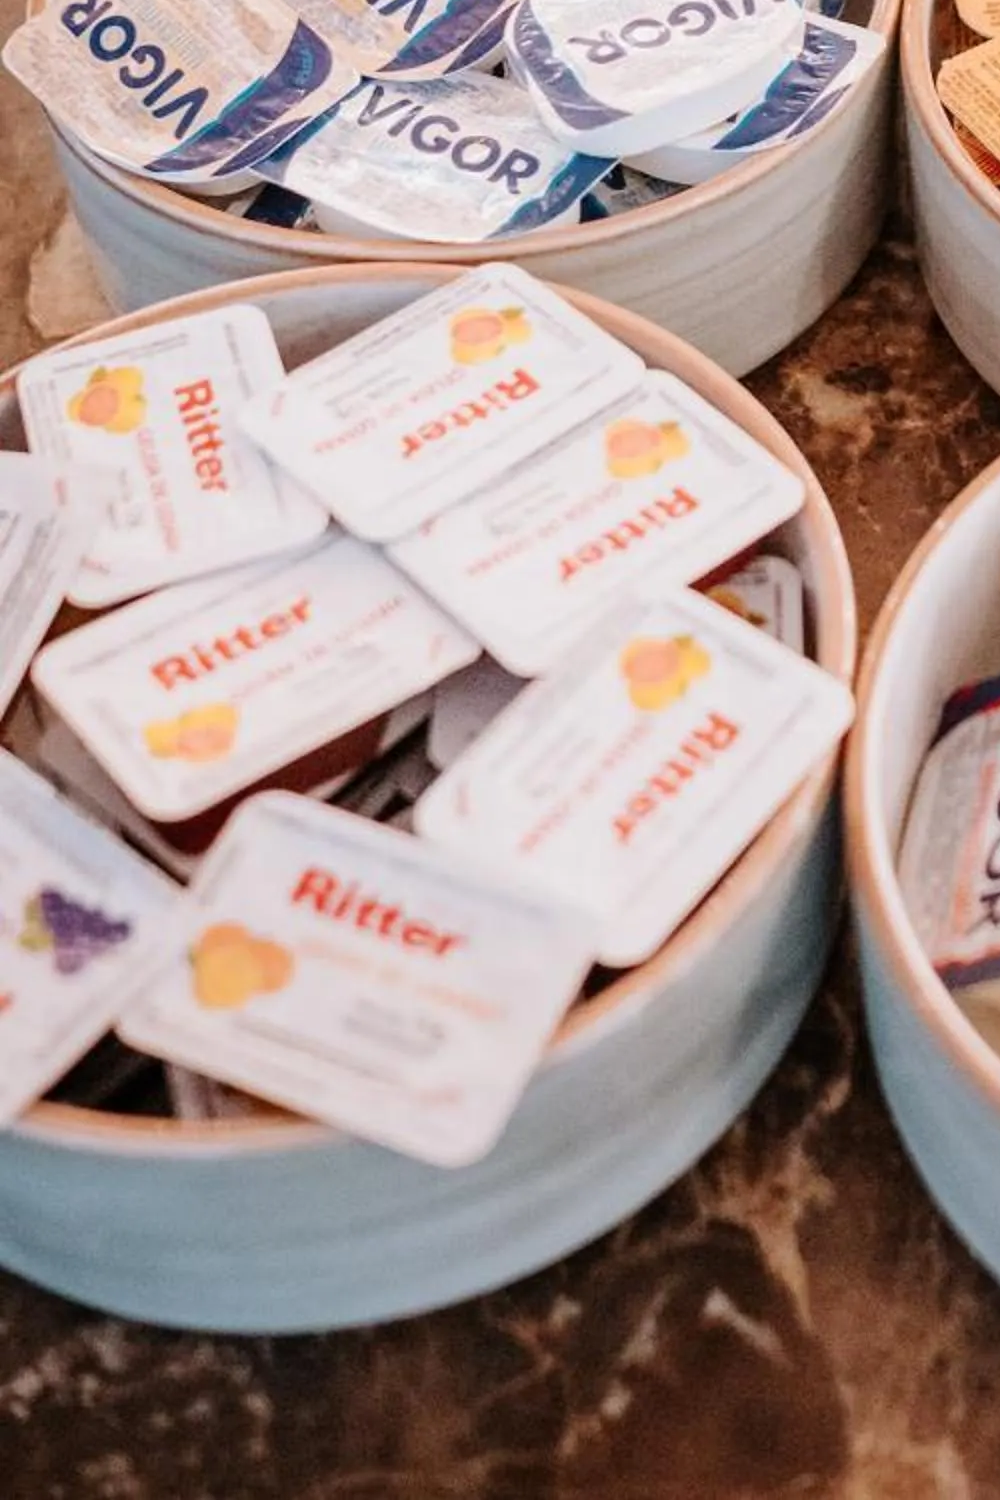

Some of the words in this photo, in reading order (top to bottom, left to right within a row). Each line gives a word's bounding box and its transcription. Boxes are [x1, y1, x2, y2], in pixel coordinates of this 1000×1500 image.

[357, 86, 540, 194] VIGOR
[174, 378, 229, 494] Ritter
[400, 368, 540, 460] Ritter
[559, 486, 700, 583] Ritter
[150, 595, 312, 691] Ritter
[612, 711, 739, 846] Ritter
[290, 867, 467, 959] Ritter
